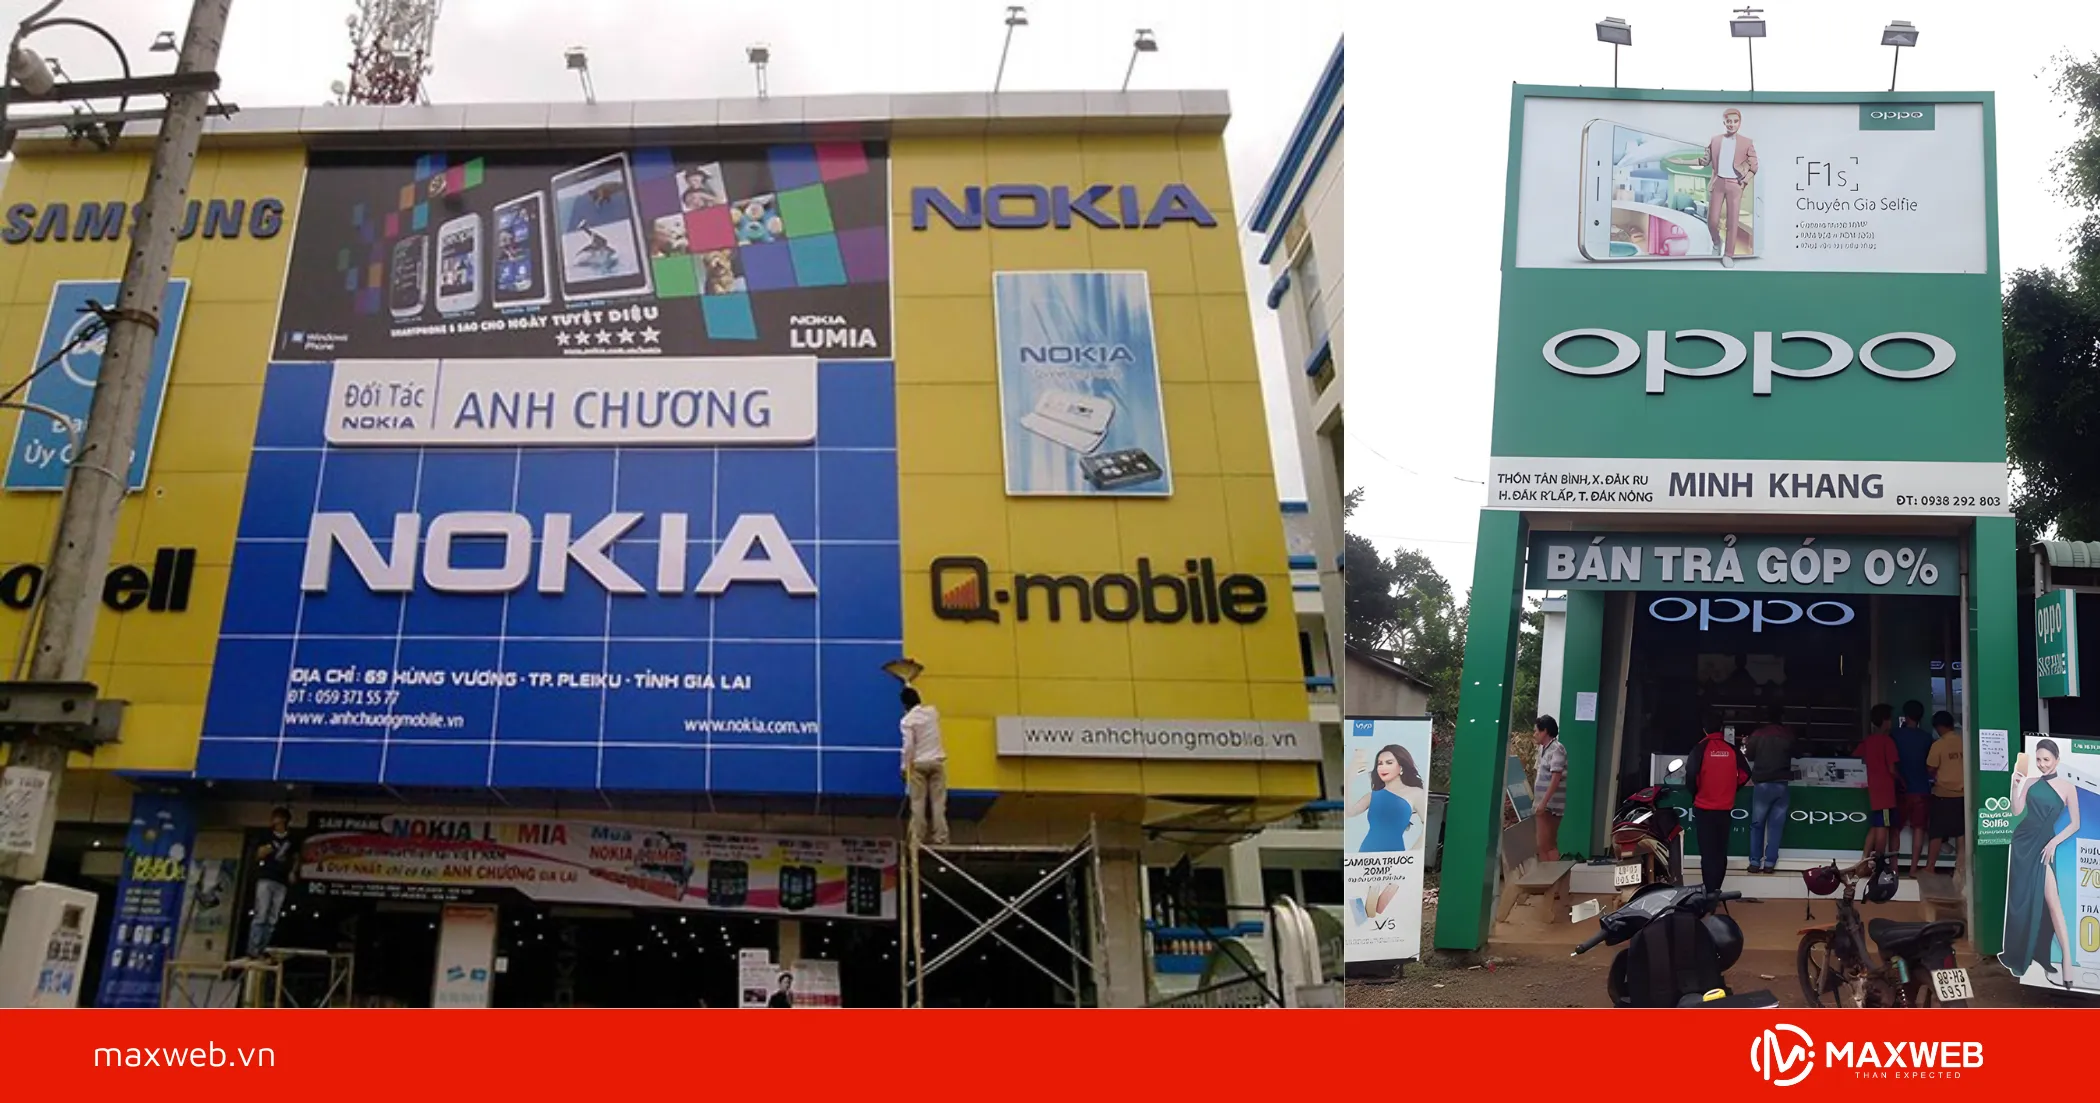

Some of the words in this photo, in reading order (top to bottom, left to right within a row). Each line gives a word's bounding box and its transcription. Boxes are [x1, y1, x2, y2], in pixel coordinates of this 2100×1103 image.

[911, 183, 1218, 231] NOKIA
[1853, 198, 1877, 212] Gia
[1880, 197, 1919, 212] Selfie
[480, 319, 506, 332] CHO
[789, 315, 848, 326] NOKIA
[789, 328, 878, 349] LUMIA
[1020, 346, 1135, 363] NOKIA
[343, 381, 382, 408] Đối
[389, 381, 425, 408] Tác
[453, 390, 556, 429] ANH
[573, 388, 772, 429] CHƯƠNG
[342, 415, 415, 429] NOKIA
[1632, 474, 1649, 486] RU
[1668, 472, 1753, 498] MINH
[1768, 473, 1885, 499] KHANG
[1921, 495, 1950, 506] 0938
[1952, 496, 1976, 506] 292
[1979, 496, 2001, 507] 803
[300, 512, 819, 595] NOKIA
[1546, 535, 1643, 582] BÁN
[1653, 533, 1745, 584] TRẢ
[1756, 536, 1852, 585] GÓP
[1863, 546, 1939, 586] 0%
[364, 669, 388, 685] 69
[451, 669, 517, 687] VƯƠNG
[556, 672, 622, 688] PLEIKU
[683, 674, 716, 690] GIA
[720, 676, 752, 690] LAI
[315, 689, 341, 705] 059
[341, 689, 364, 705] 371
[365, 690, 382, 706] 55
[683, 717, 820, 734] www.nokia.com.vn
[391, 818, 473, 840] NOKIA
[483, 821, 568, 846] LUMIA
[588, 845, 633, 861] NOKIA
[1940, 984, 1968, 999] 6957
